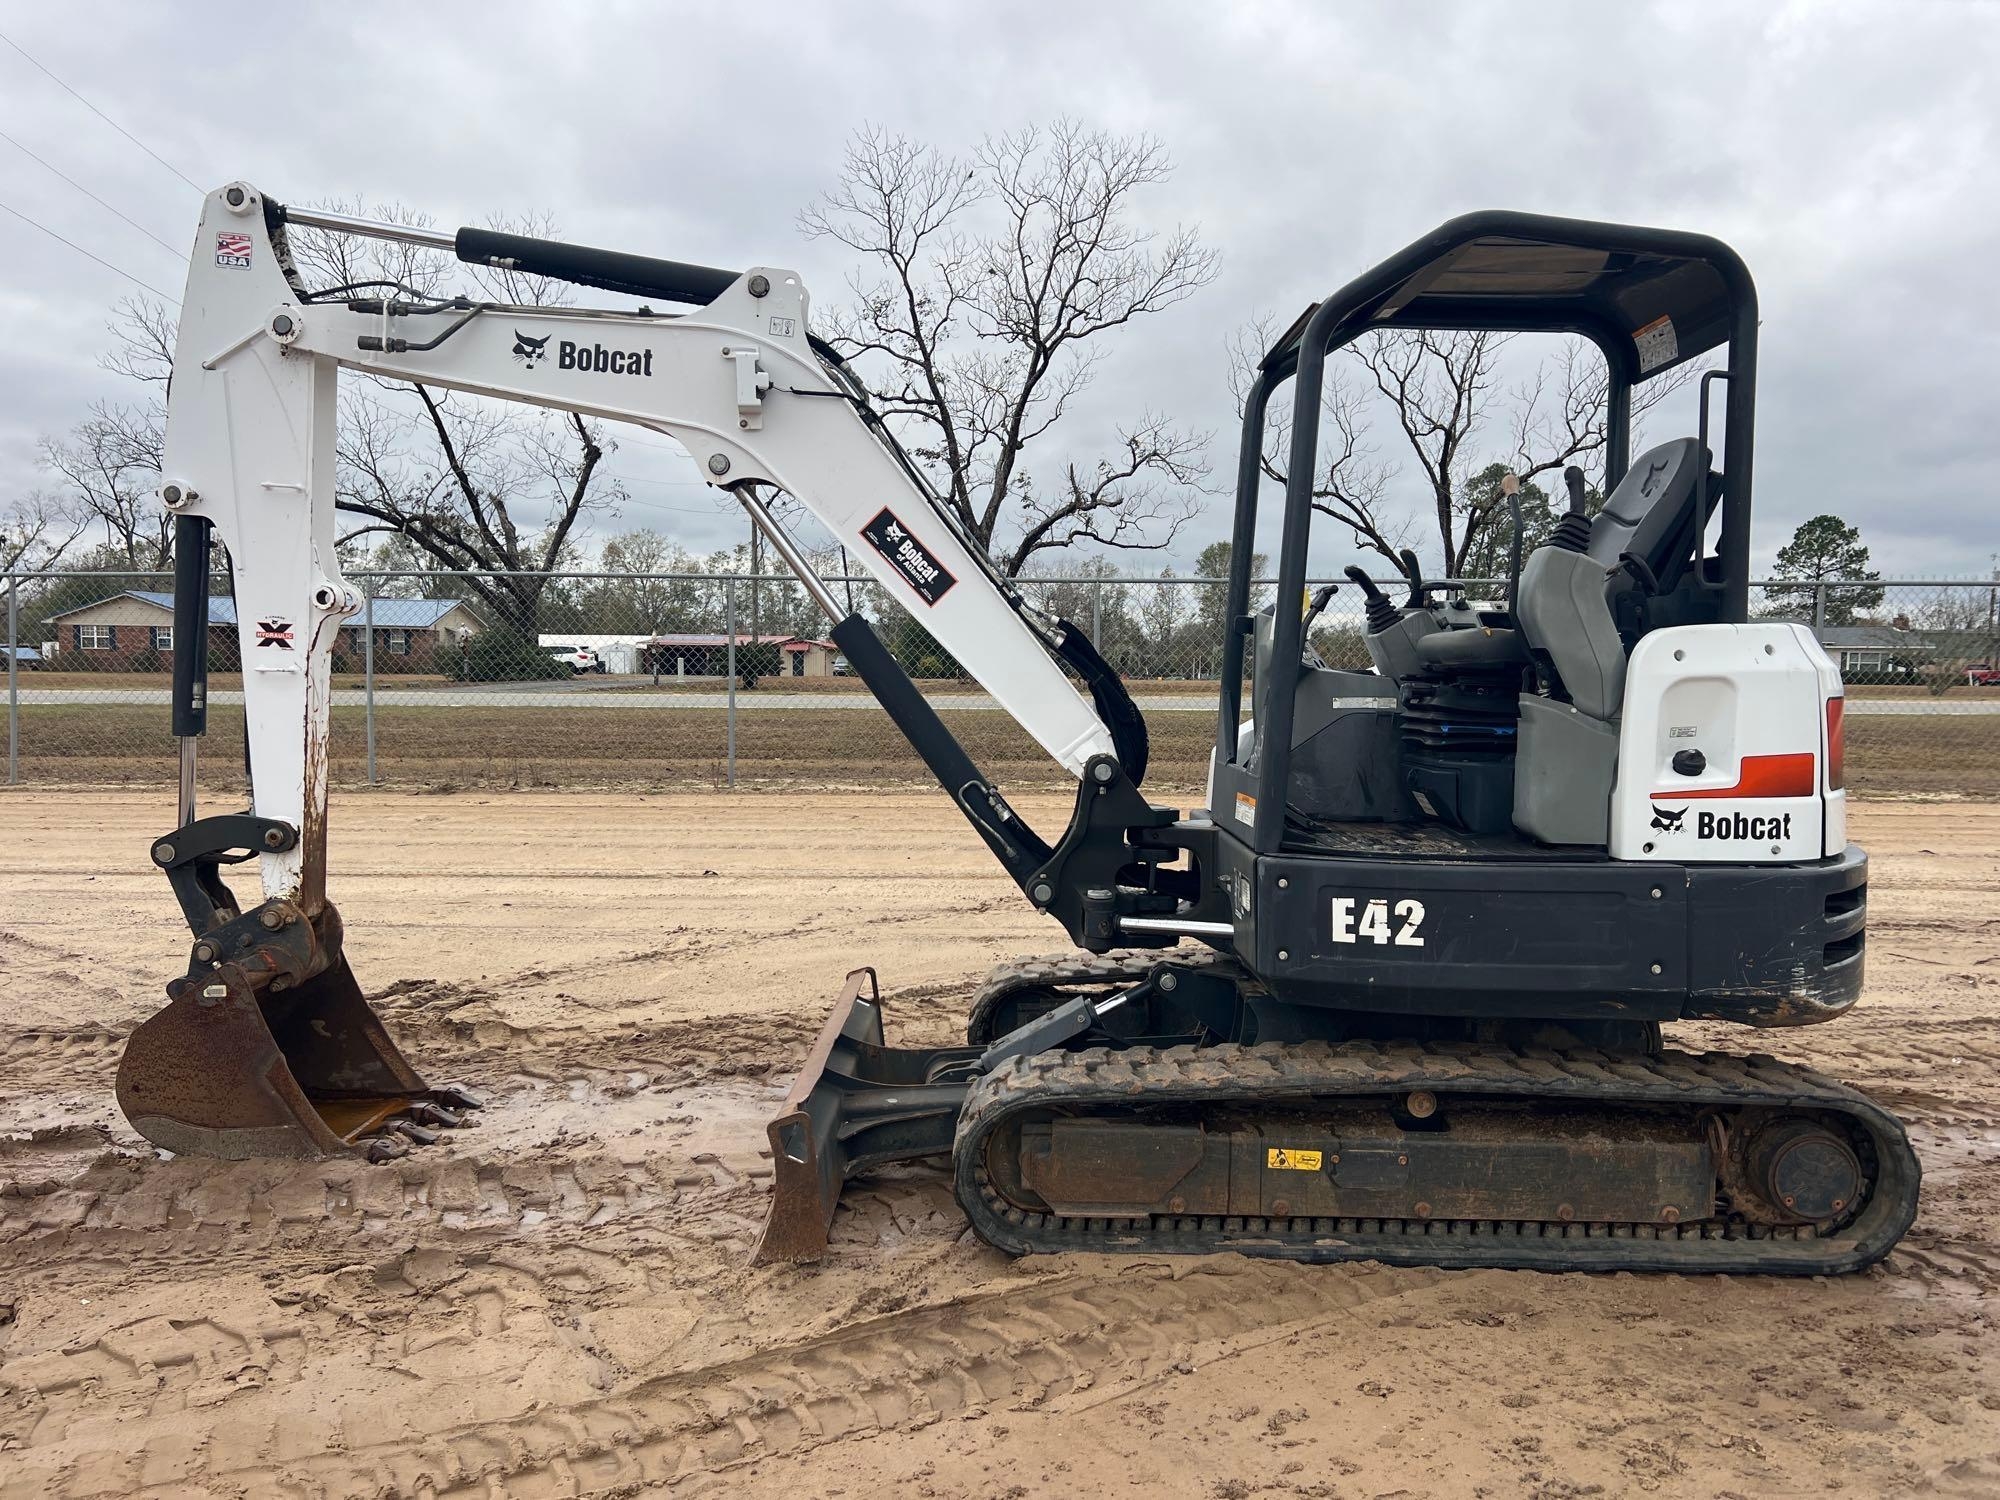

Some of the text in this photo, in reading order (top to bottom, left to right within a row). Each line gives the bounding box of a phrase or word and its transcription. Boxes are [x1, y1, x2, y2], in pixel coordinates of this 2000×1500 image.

[218, 256, 248, 266] USA
[559, 341, 653, 377] Bobcat
[896, 553, 906, 562] of
[902, 560, 926, 584] Atlanta
[898, 539, 940, 582] Bobcat
[1698, 812, 1791, 840] Bobcat
[1332, 898, 1425, 946] E42
